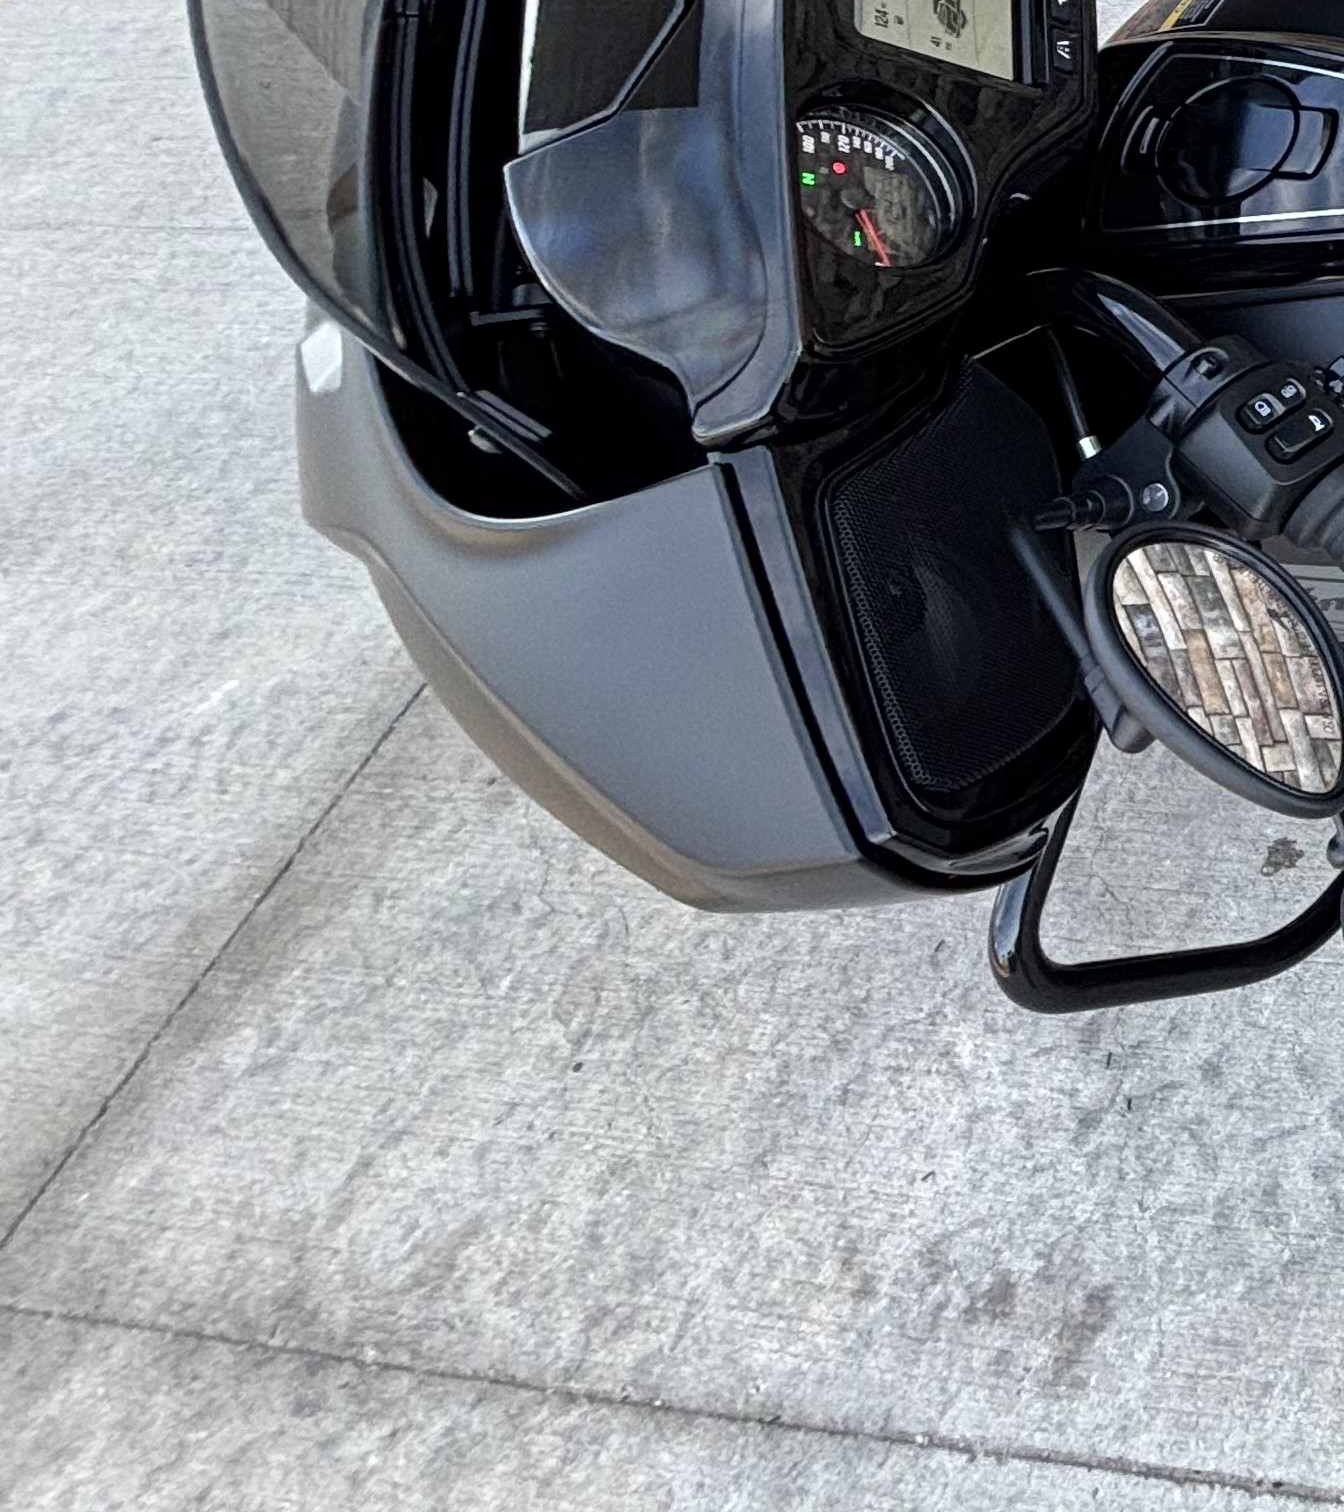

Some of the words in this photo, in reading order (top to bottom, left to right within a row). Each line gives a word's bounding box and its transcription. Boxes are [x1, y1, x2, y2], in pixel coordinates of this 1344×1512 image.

[874, 7, 889, 28] 124
[802, 134, 815, 154] 100
[838, 134, 851, 154] 120
[802, 172, 816, 186] N
